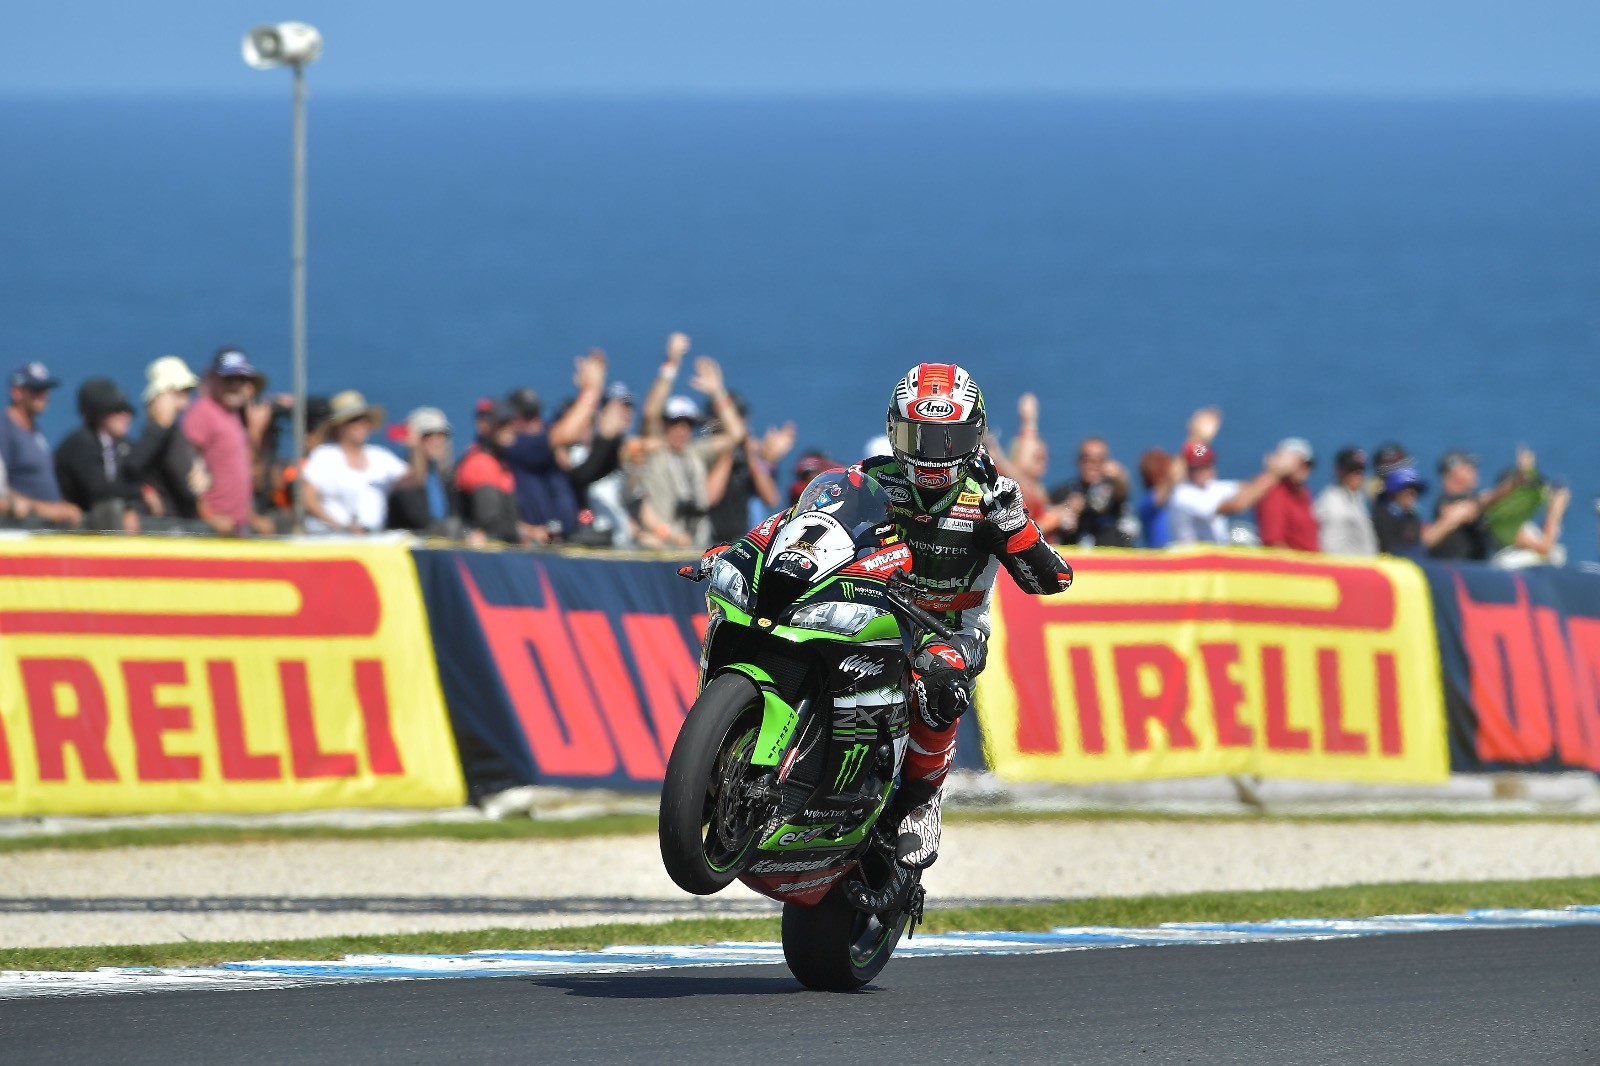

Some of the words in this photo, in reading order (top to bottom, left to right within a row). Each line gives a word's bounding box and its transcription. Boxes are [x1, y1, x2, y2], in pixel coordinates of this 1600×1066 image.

[917, 402, 949, 413] Arai
[921, 478, 940, 486] PATA
[802, 513, 838, 529] Kawasaki
[785, 522, 831, 562] 1
[908, 539, 968, 555] MONSTER
[996, 554, 1402, 757] PIRELLI
[838, 654, 885, 681] Ninja
